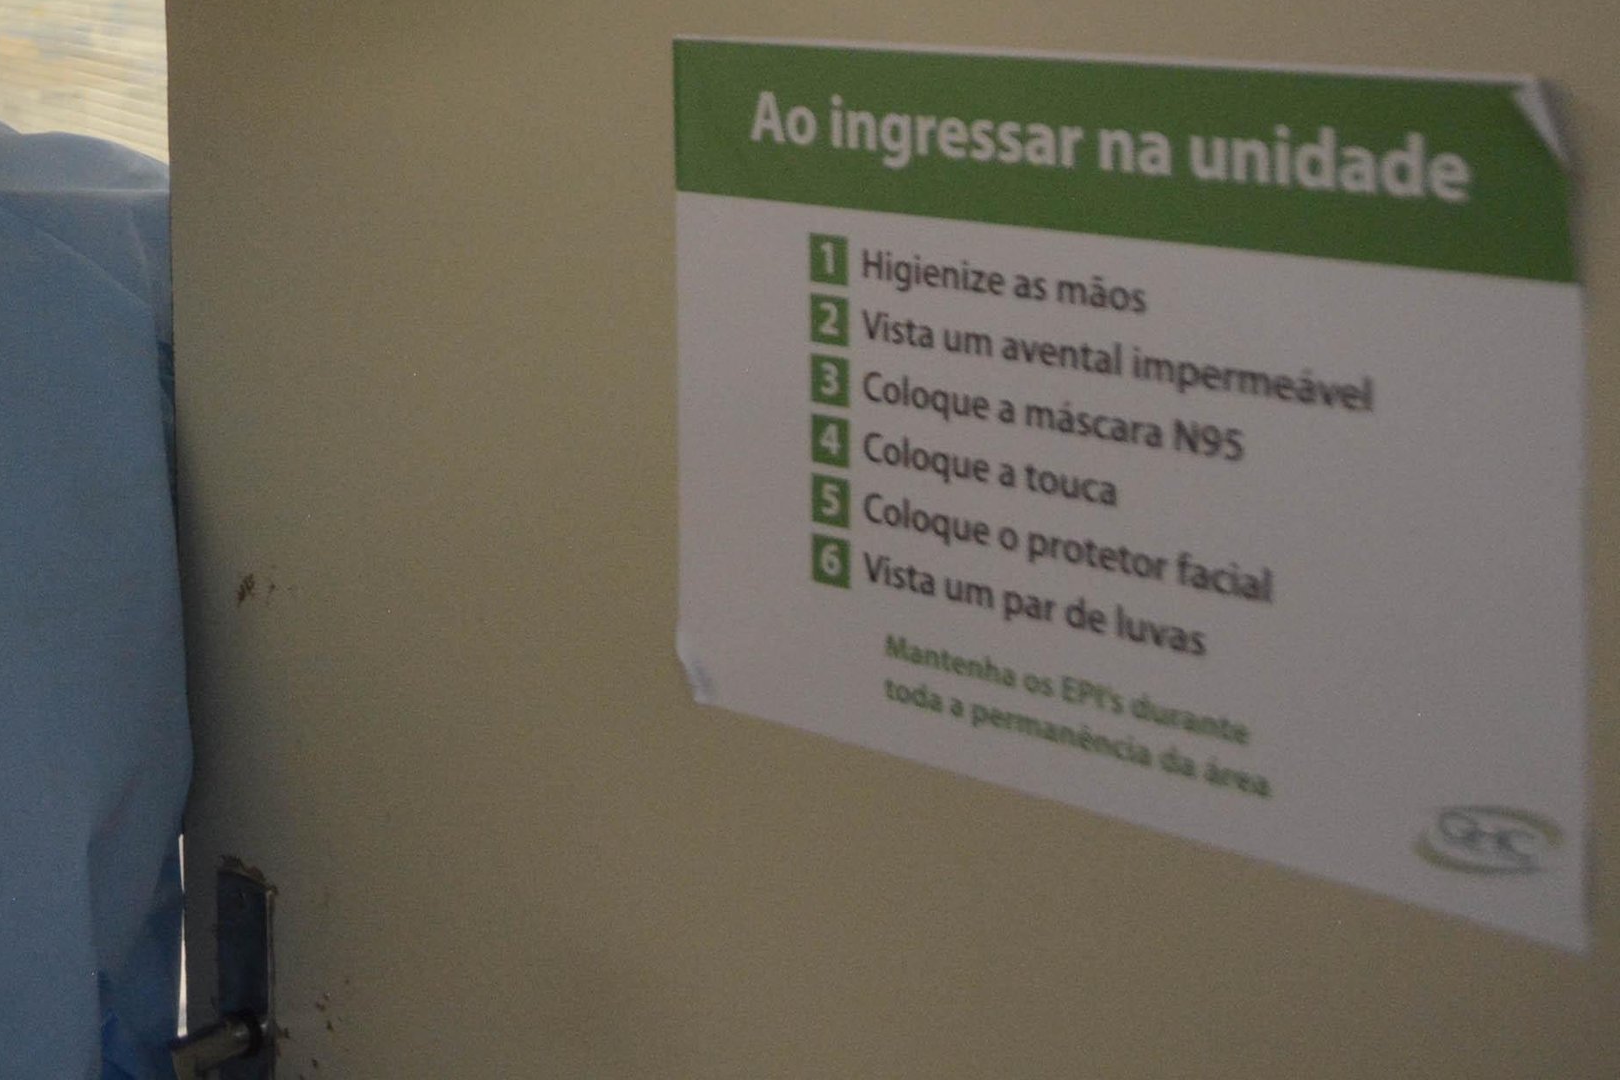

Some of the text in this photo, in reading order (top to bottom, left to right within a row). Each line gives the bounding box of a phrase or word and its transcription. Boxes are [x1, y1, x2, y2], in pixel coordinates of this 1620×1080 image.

[748, 89, 1471, 203] Ao ingressar na unidade
[820, 241, 1147, 314] 1 Higienize as mãos
[818, 300, 1374, 413] 2 Vista um avental impermeável
[819, 361, 1245, 463] 3 Coloque a máscara N95
[818, 420, 1118, 508] 4 Coloque a touca
[819, 544, 1208, 657] 6 Vista um par de luvas
[820, 483, 1275, 605] 5 Coloque o protetor facial
[885, 678, 1273, 798] toda a permanência da área
[886, 632, 1018, 687] Mantenha
[1023, 672, 1054, 698] os
[1132, 693, 1252, 746] durante
